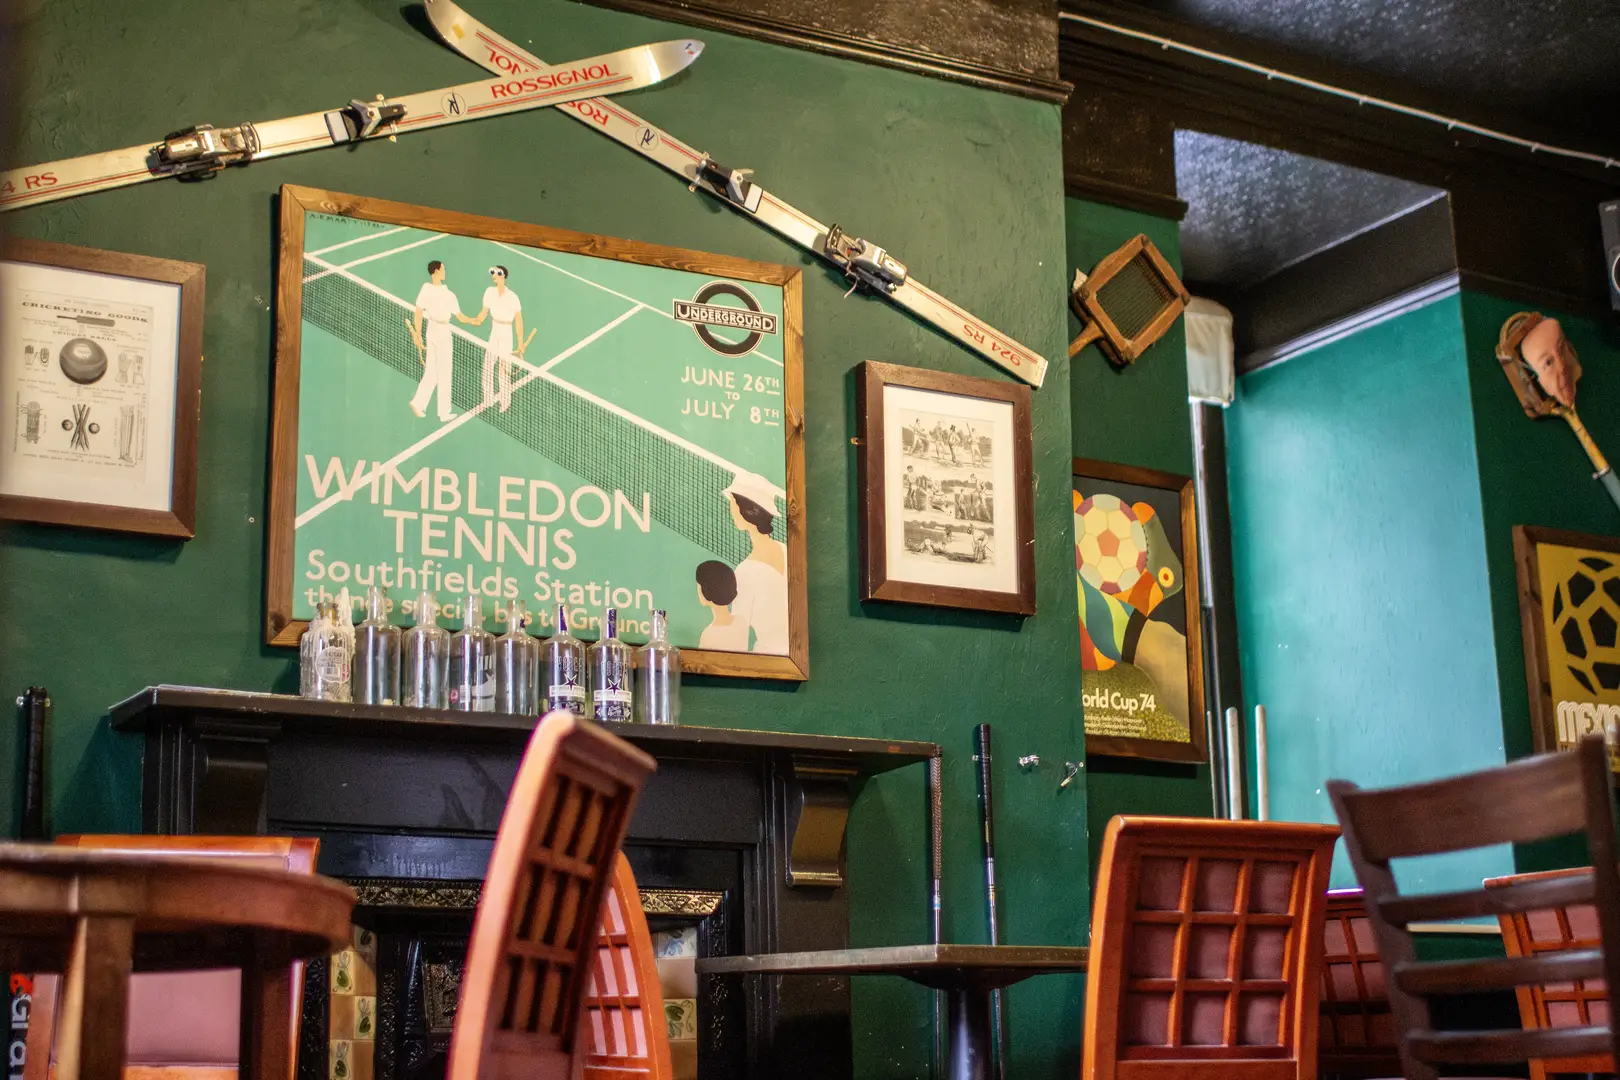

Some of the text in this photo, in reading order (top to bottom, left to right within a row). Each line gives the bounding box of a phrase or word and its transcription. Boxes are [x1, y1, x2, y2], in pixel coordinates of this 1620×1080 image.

[491, 64, 619, 99] ROSSIGNOL
[24, 172, 58, 190] RS
[22, 301, 102, 316] CRICKETING
[677, 303, 775, 331] UNDERGROUND
[963, 324, 1021, 366] 924 RS
[681, 366, 781, 395] JUNE 26TH
[725, 391, 741, 401] TO
[681, 398, 780, 426] JULY 8TH
[305, 454, 650, 532] WIMBLEDON
[383, 509, 577, 570] TENNIS
[306, 549, 653, 610] Southfields Station
[304, 585, 394, 613] thne
[494, 600, 533, 624] bs
[570, 608, 653, 634] Grun
[1082, 688, 1156, 716] orld Cup 74
